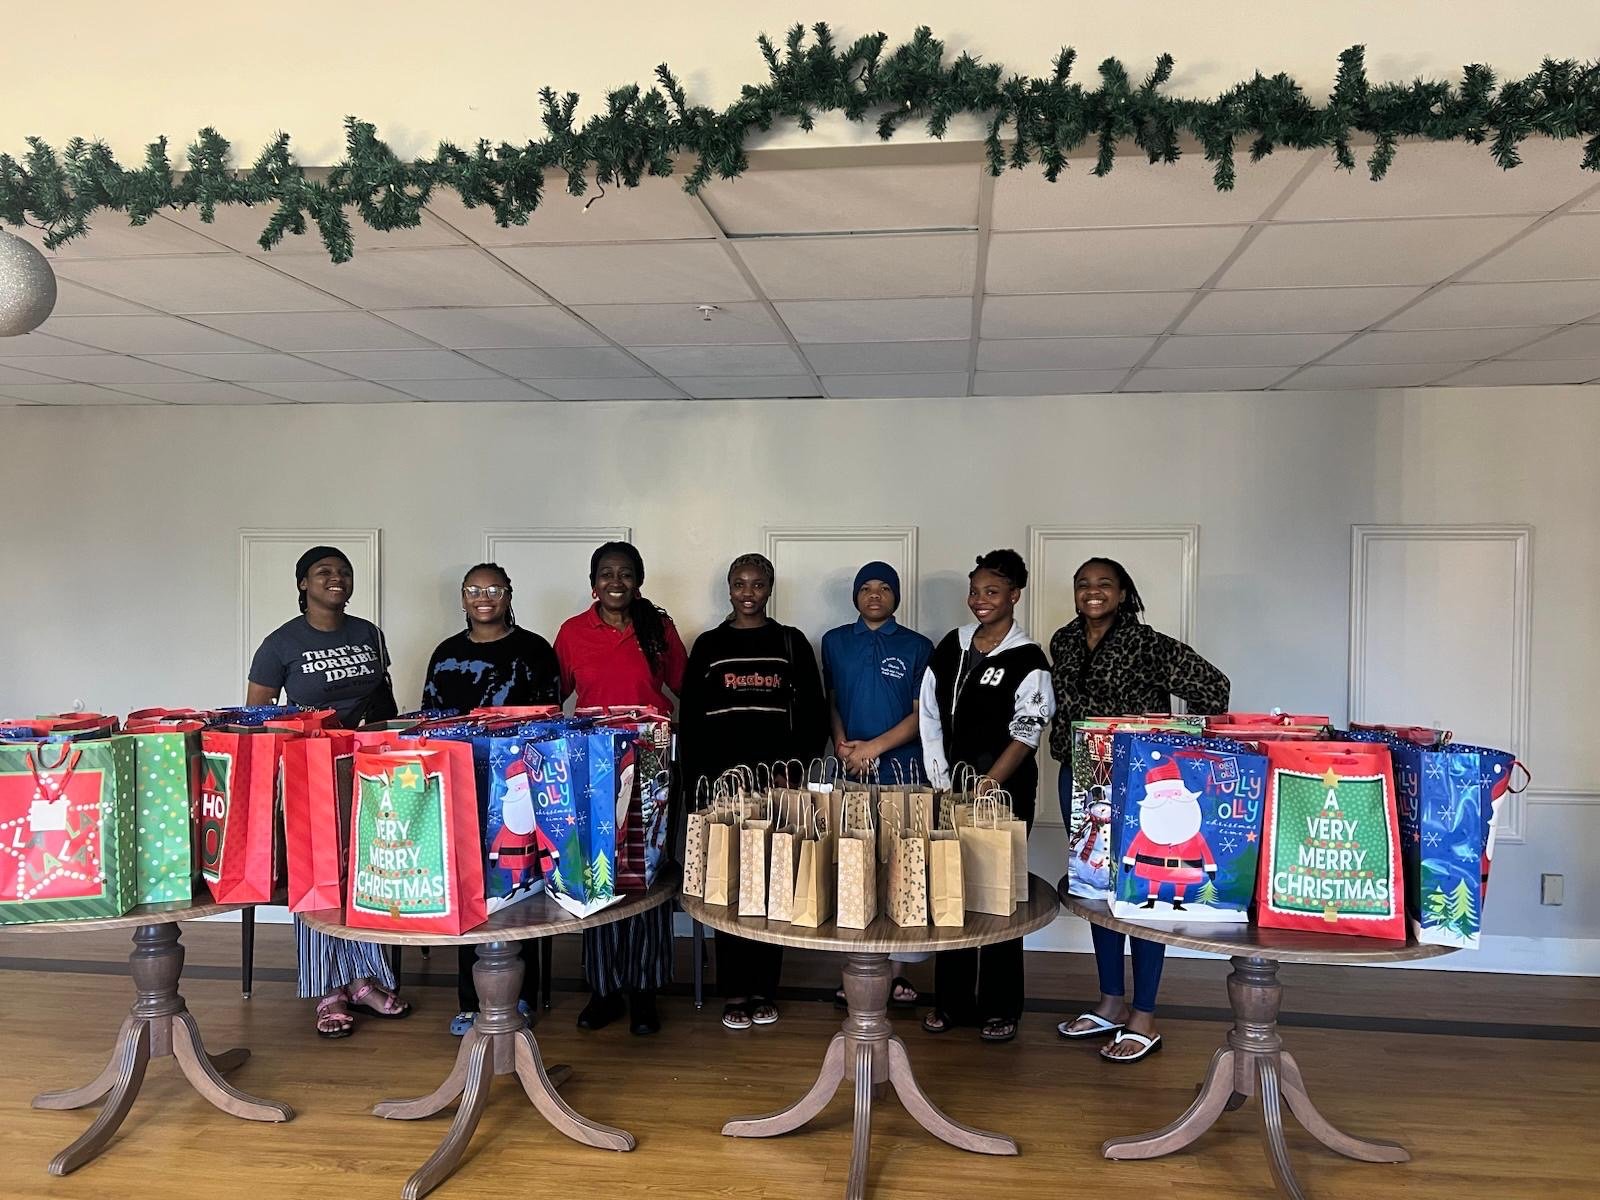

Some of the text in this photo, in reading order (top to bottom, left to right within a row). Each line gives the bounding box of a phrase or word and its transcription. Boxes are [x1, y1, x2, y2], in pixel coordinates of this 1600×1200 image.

[302, 645, 362, 661] THAT'S
[325, 665, 375, 682] IDEA.
[531, 759, 567, 783] OLLY
[202, 793, 226, 819] HO
[380, 789, 393, 811] A
[1214, 798, 1259, 823] OLLY
[1324, 789, 1340, 810] A
[1306, 816, 1358, 841] VERY
[370, 846, 421, 870] MERRY
[1300, 845, 1367, 871] MERRY
[357, 871, 443, 899] CHRISTMAS
[1274, 872, 1389, 900] CHRISTMAS
